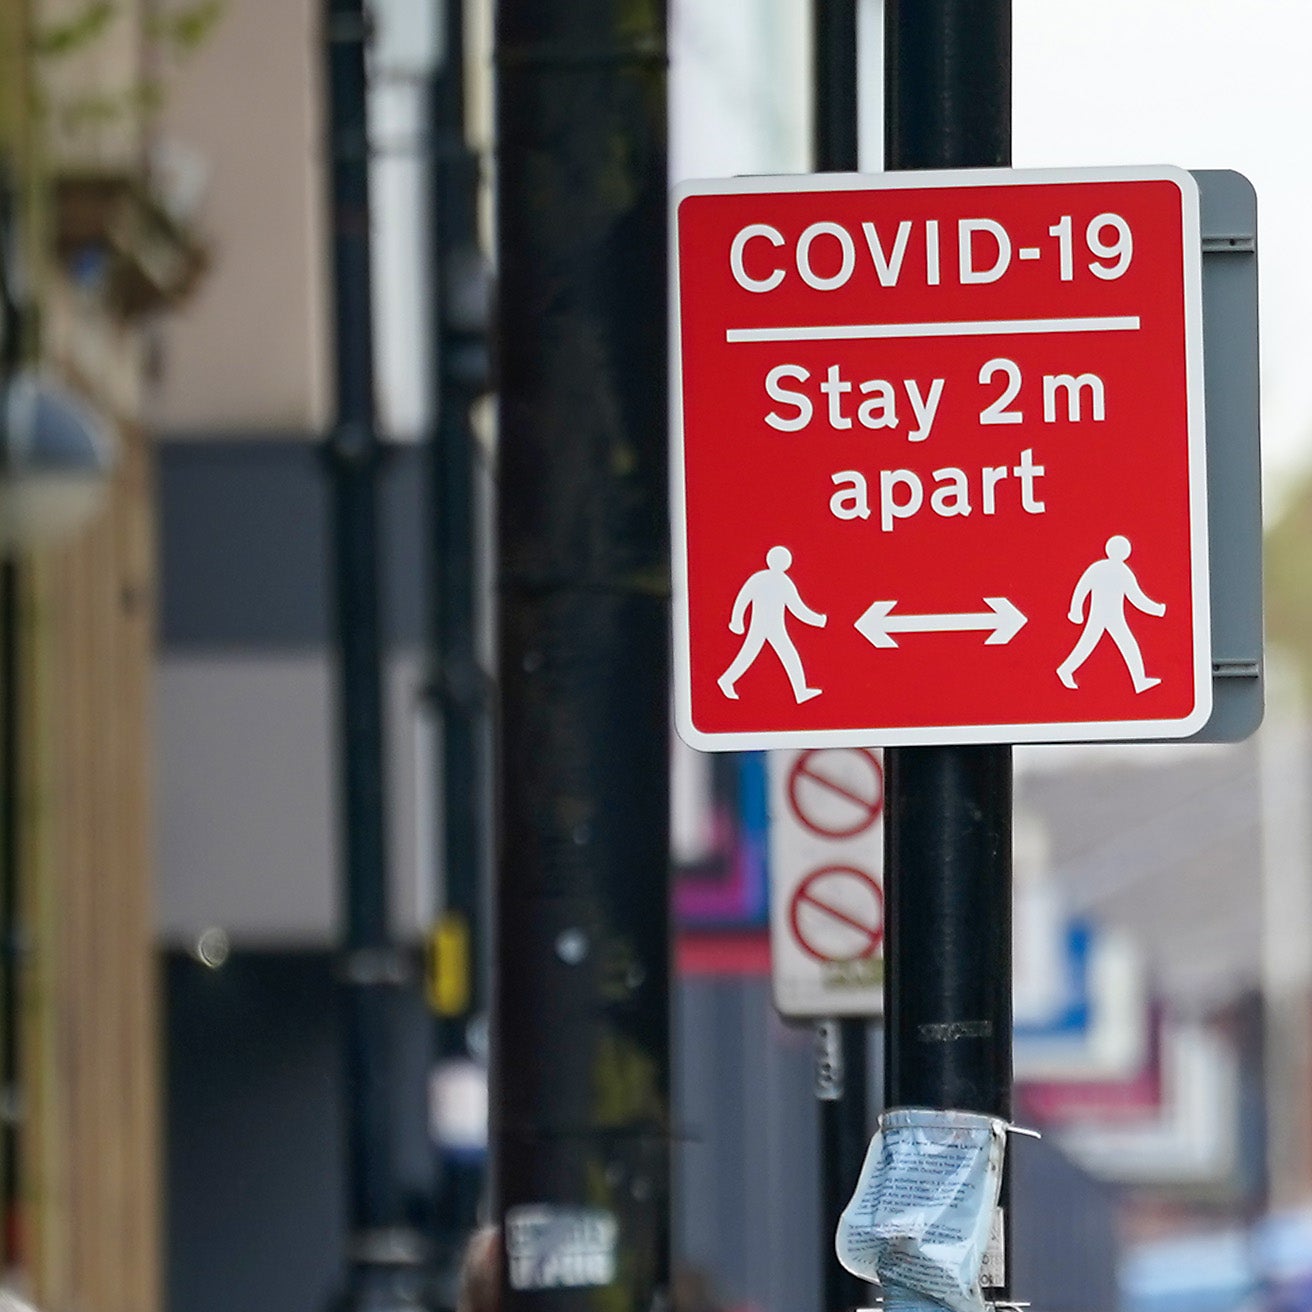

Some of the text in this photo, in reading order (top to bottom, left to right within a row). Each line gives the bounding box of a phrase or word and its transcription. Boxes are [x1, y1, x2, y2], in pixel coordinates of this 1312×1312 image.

[729, 212, 1134, 293] COVID-19
[763, 364, 945, 442] Stay
[828, 448, 1046, 532] apart
